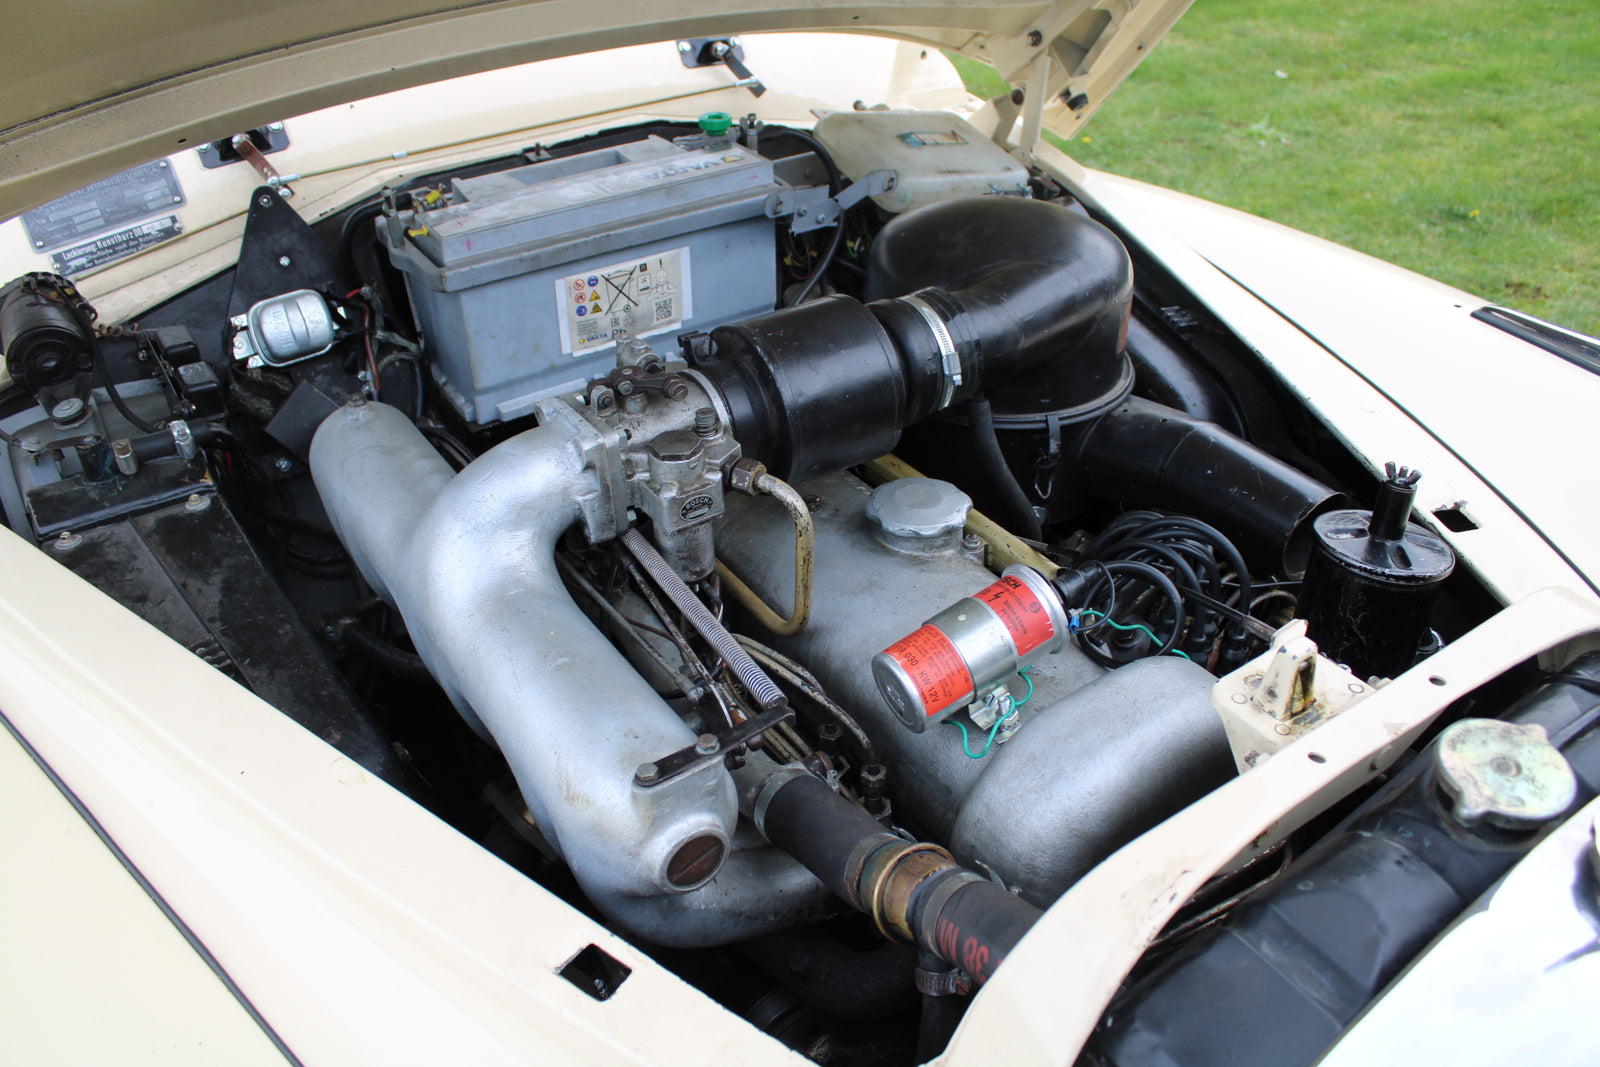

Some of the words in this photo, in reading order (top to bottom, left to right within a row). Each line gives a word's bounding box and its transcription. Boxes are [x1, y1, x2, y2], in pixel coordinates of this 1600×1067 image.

[97, 232, 133, 249] Kunstharz
[586, 332, 608, 343] VARTA
[686, 497, 710, 509] BOSCH
[904, 651, 919, 666] 030
[919, 670, 932, 686] KW
[928, 686, 940, 703] 12V
